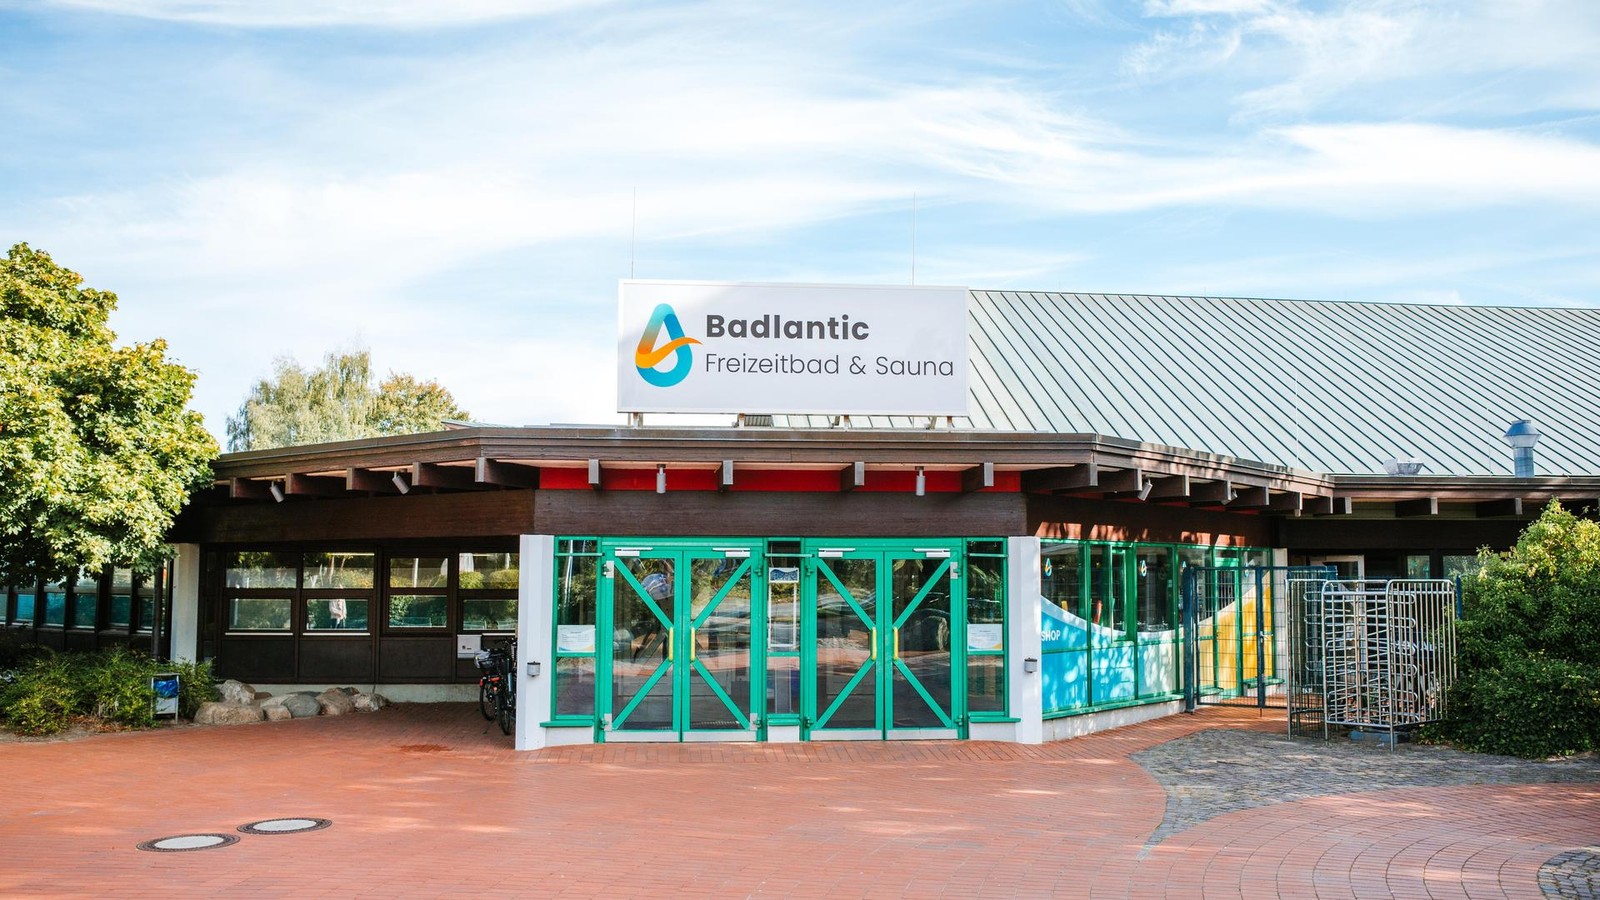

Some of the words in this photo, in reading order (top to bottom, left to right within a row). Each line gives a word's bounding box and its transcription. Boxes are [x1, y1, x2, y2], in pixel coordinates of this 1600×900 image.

[706, 314, 870, 340] Badlantic
[705, 353, 839, 375] Freizeitbad
[850, 356, 867, 375] &
[876, 357, 954, 377] Sauna
